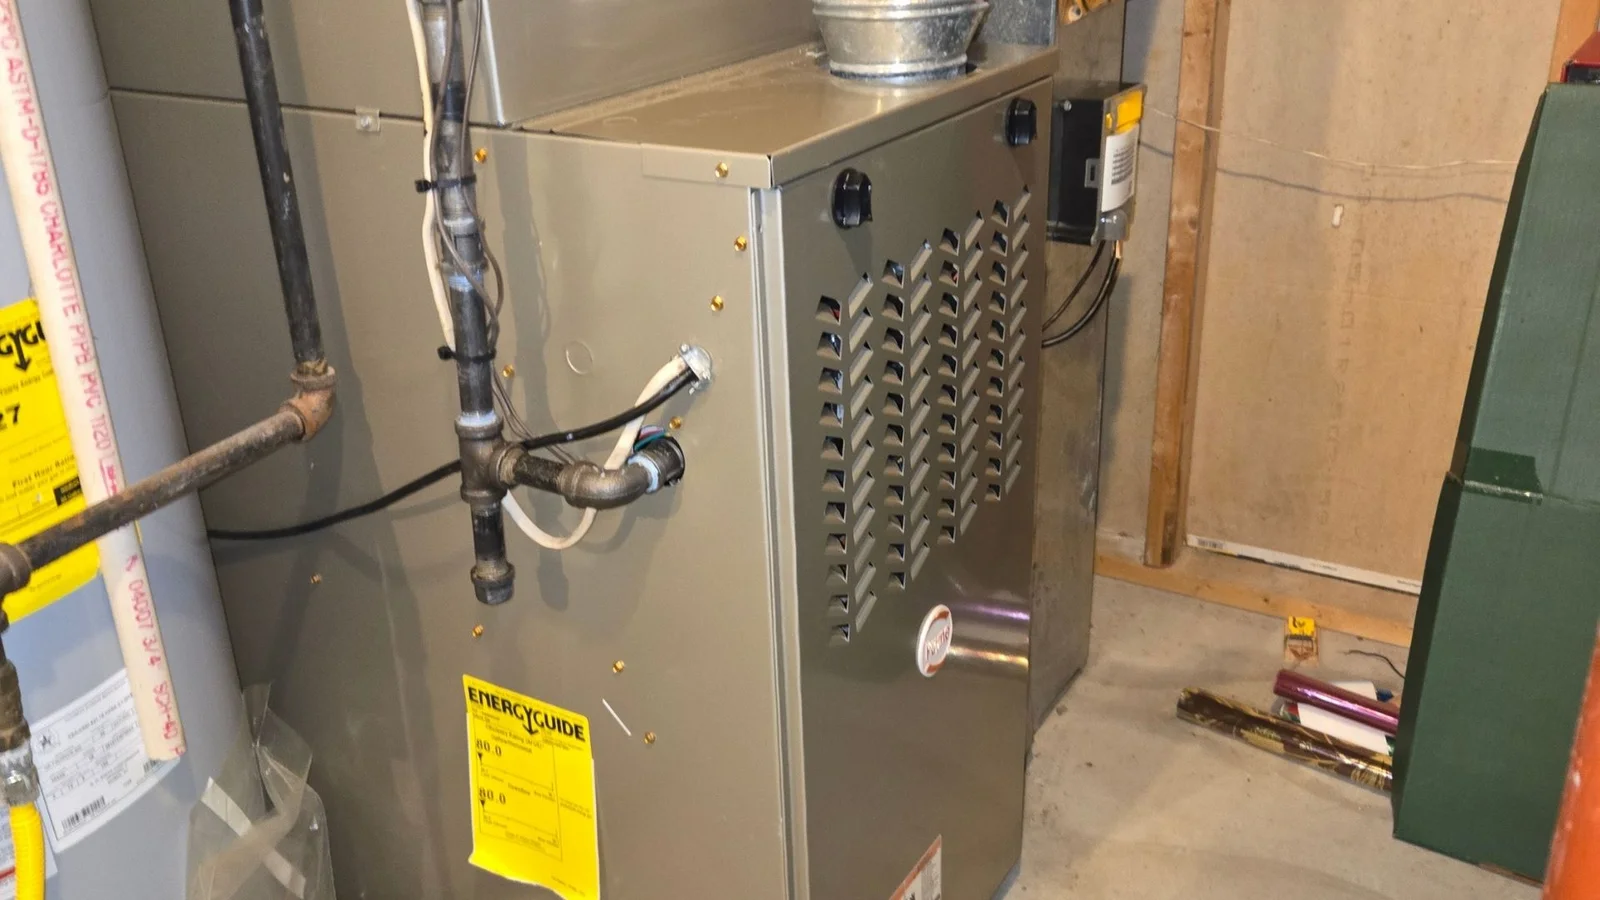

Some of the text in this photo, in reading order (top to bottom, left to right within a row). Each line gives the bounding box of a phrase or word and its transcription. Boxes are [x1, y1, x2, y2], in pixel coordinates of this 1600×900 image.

[40, 201, 80, 317] CHARLOTTE
[79, 368, 103, 409] PVC
[467, 685, 586, 742] ENERGYGUIDE
[476, 738, 502, 757] 80.0
[479, 786, 507, 805] 80.0
